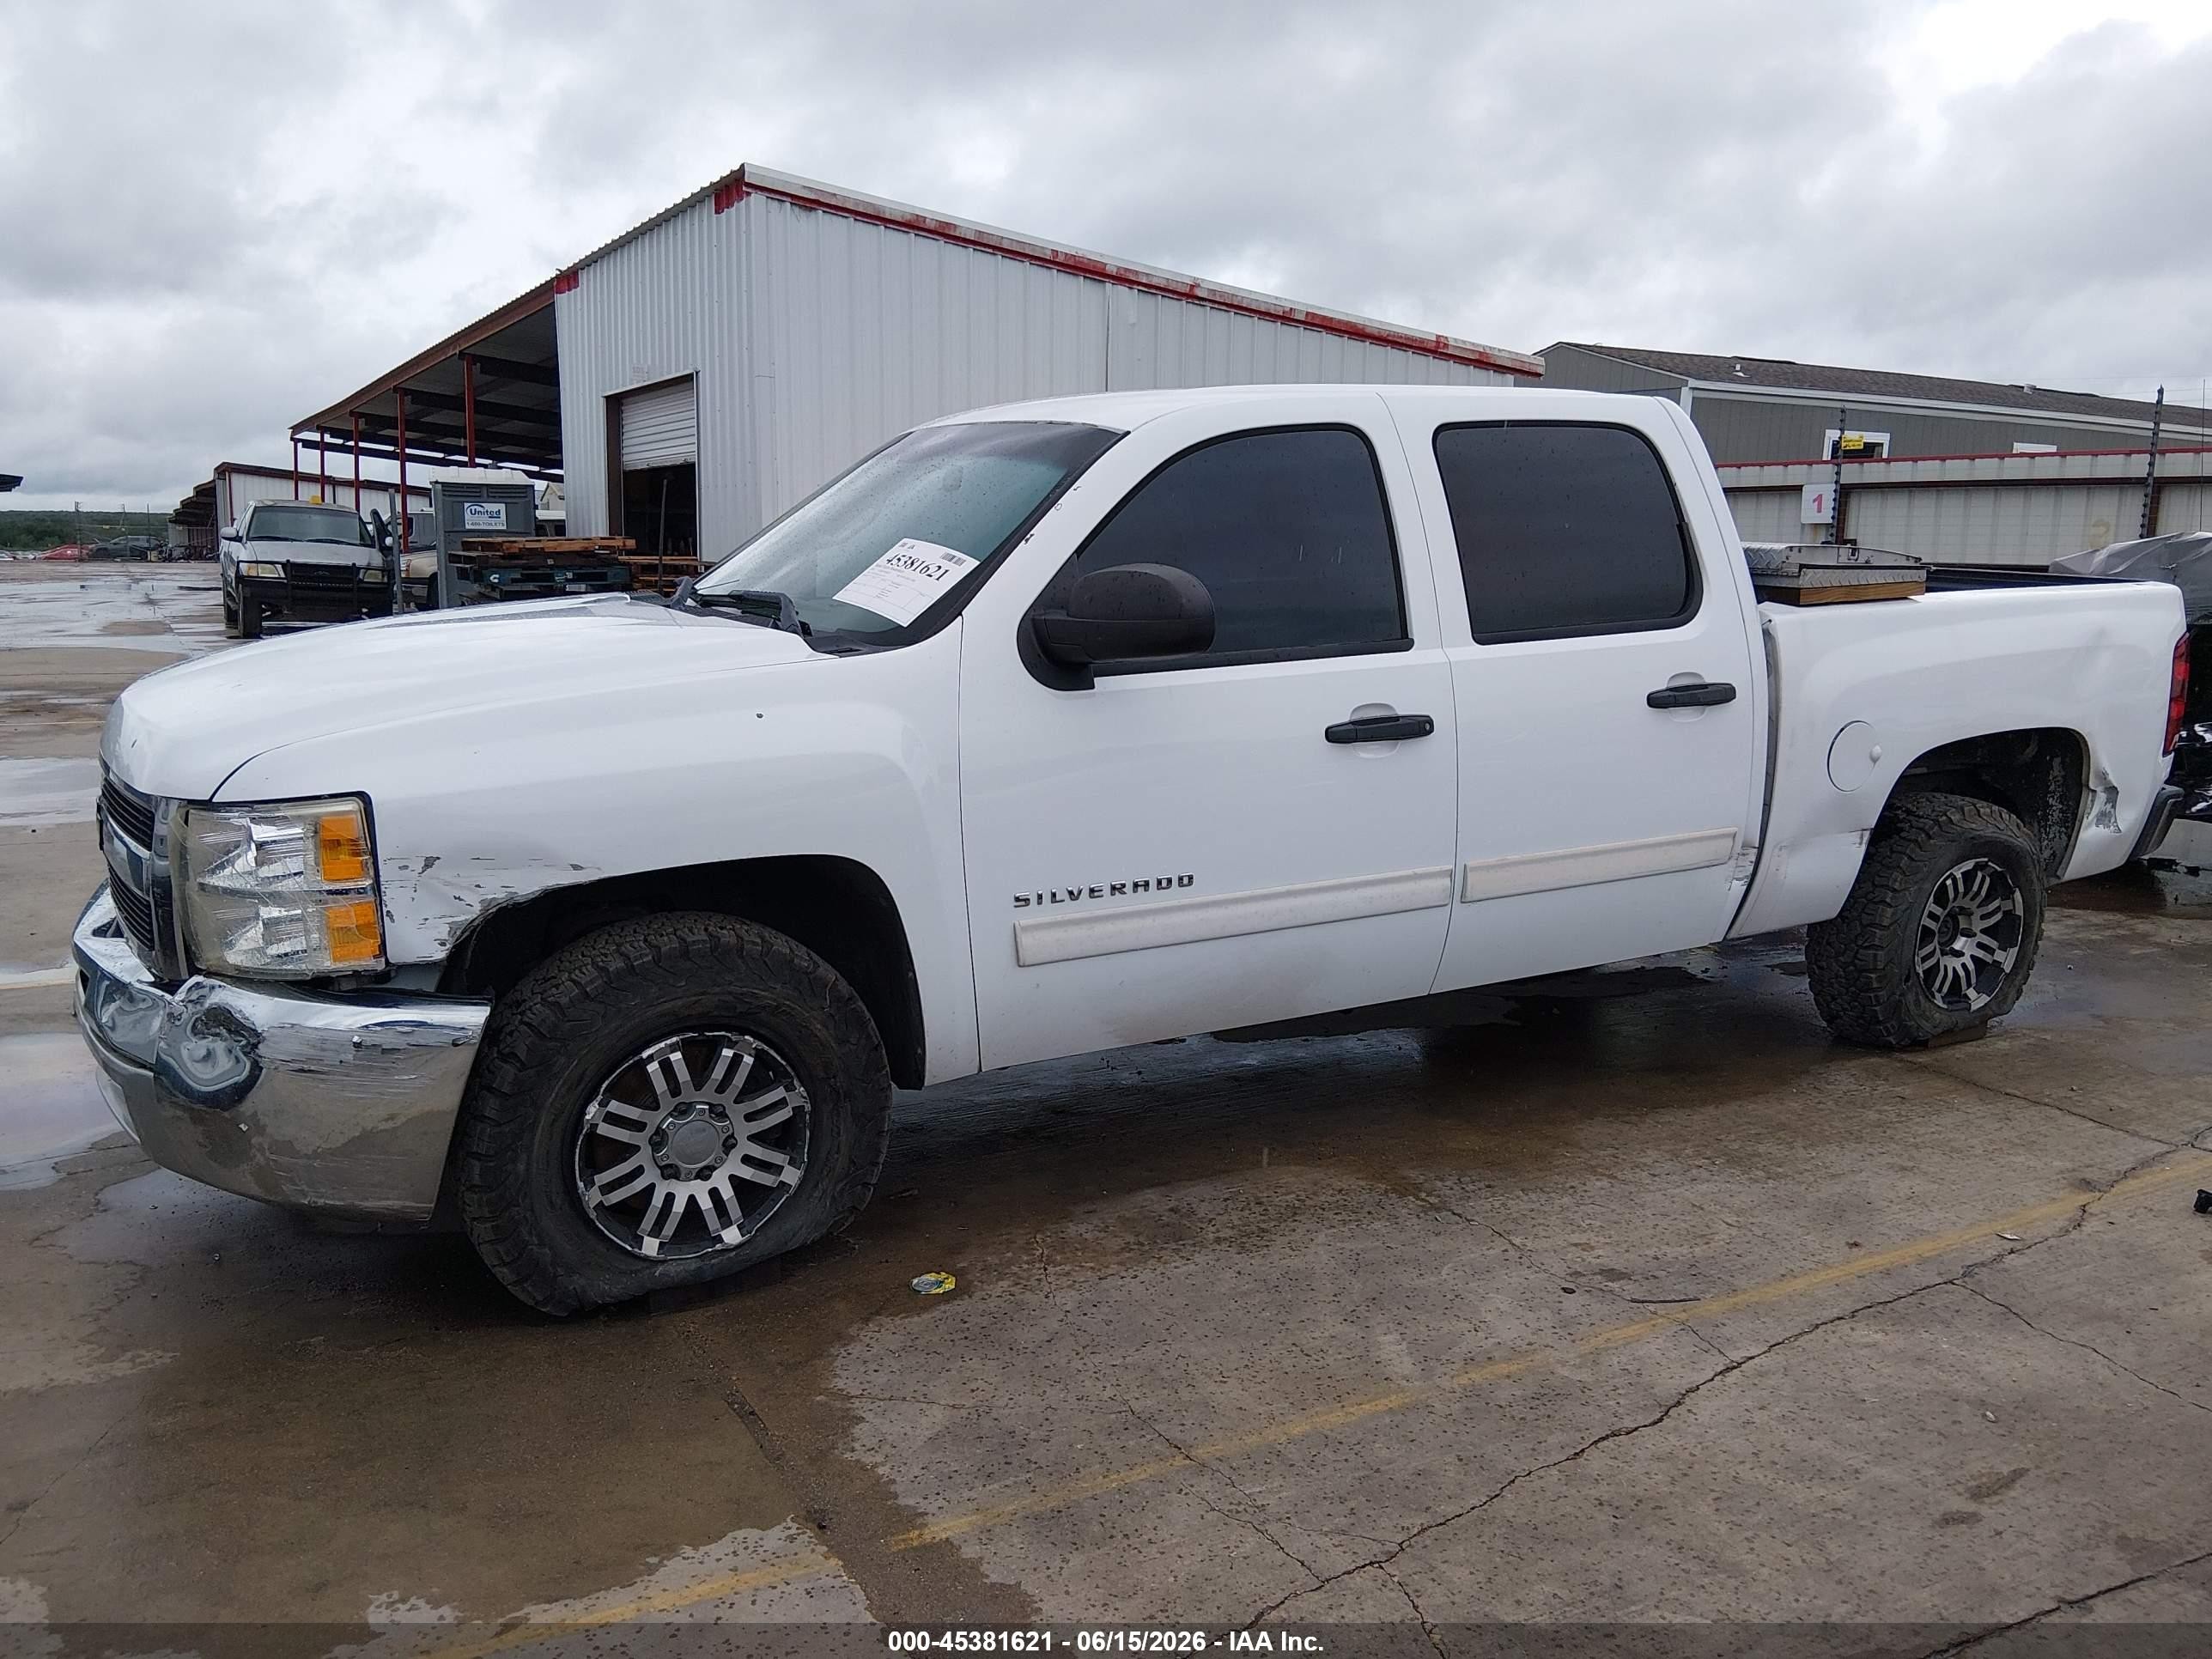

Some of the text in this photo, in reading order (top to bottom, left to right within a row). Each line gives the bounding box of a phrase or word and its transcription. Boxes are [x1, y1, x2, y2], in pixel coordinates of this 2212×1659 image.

[1813, 494, 1823, 514] 1
[886, 553, 950, 581] 45381621
[1013, 872, 1194, 908] SILVERADO
